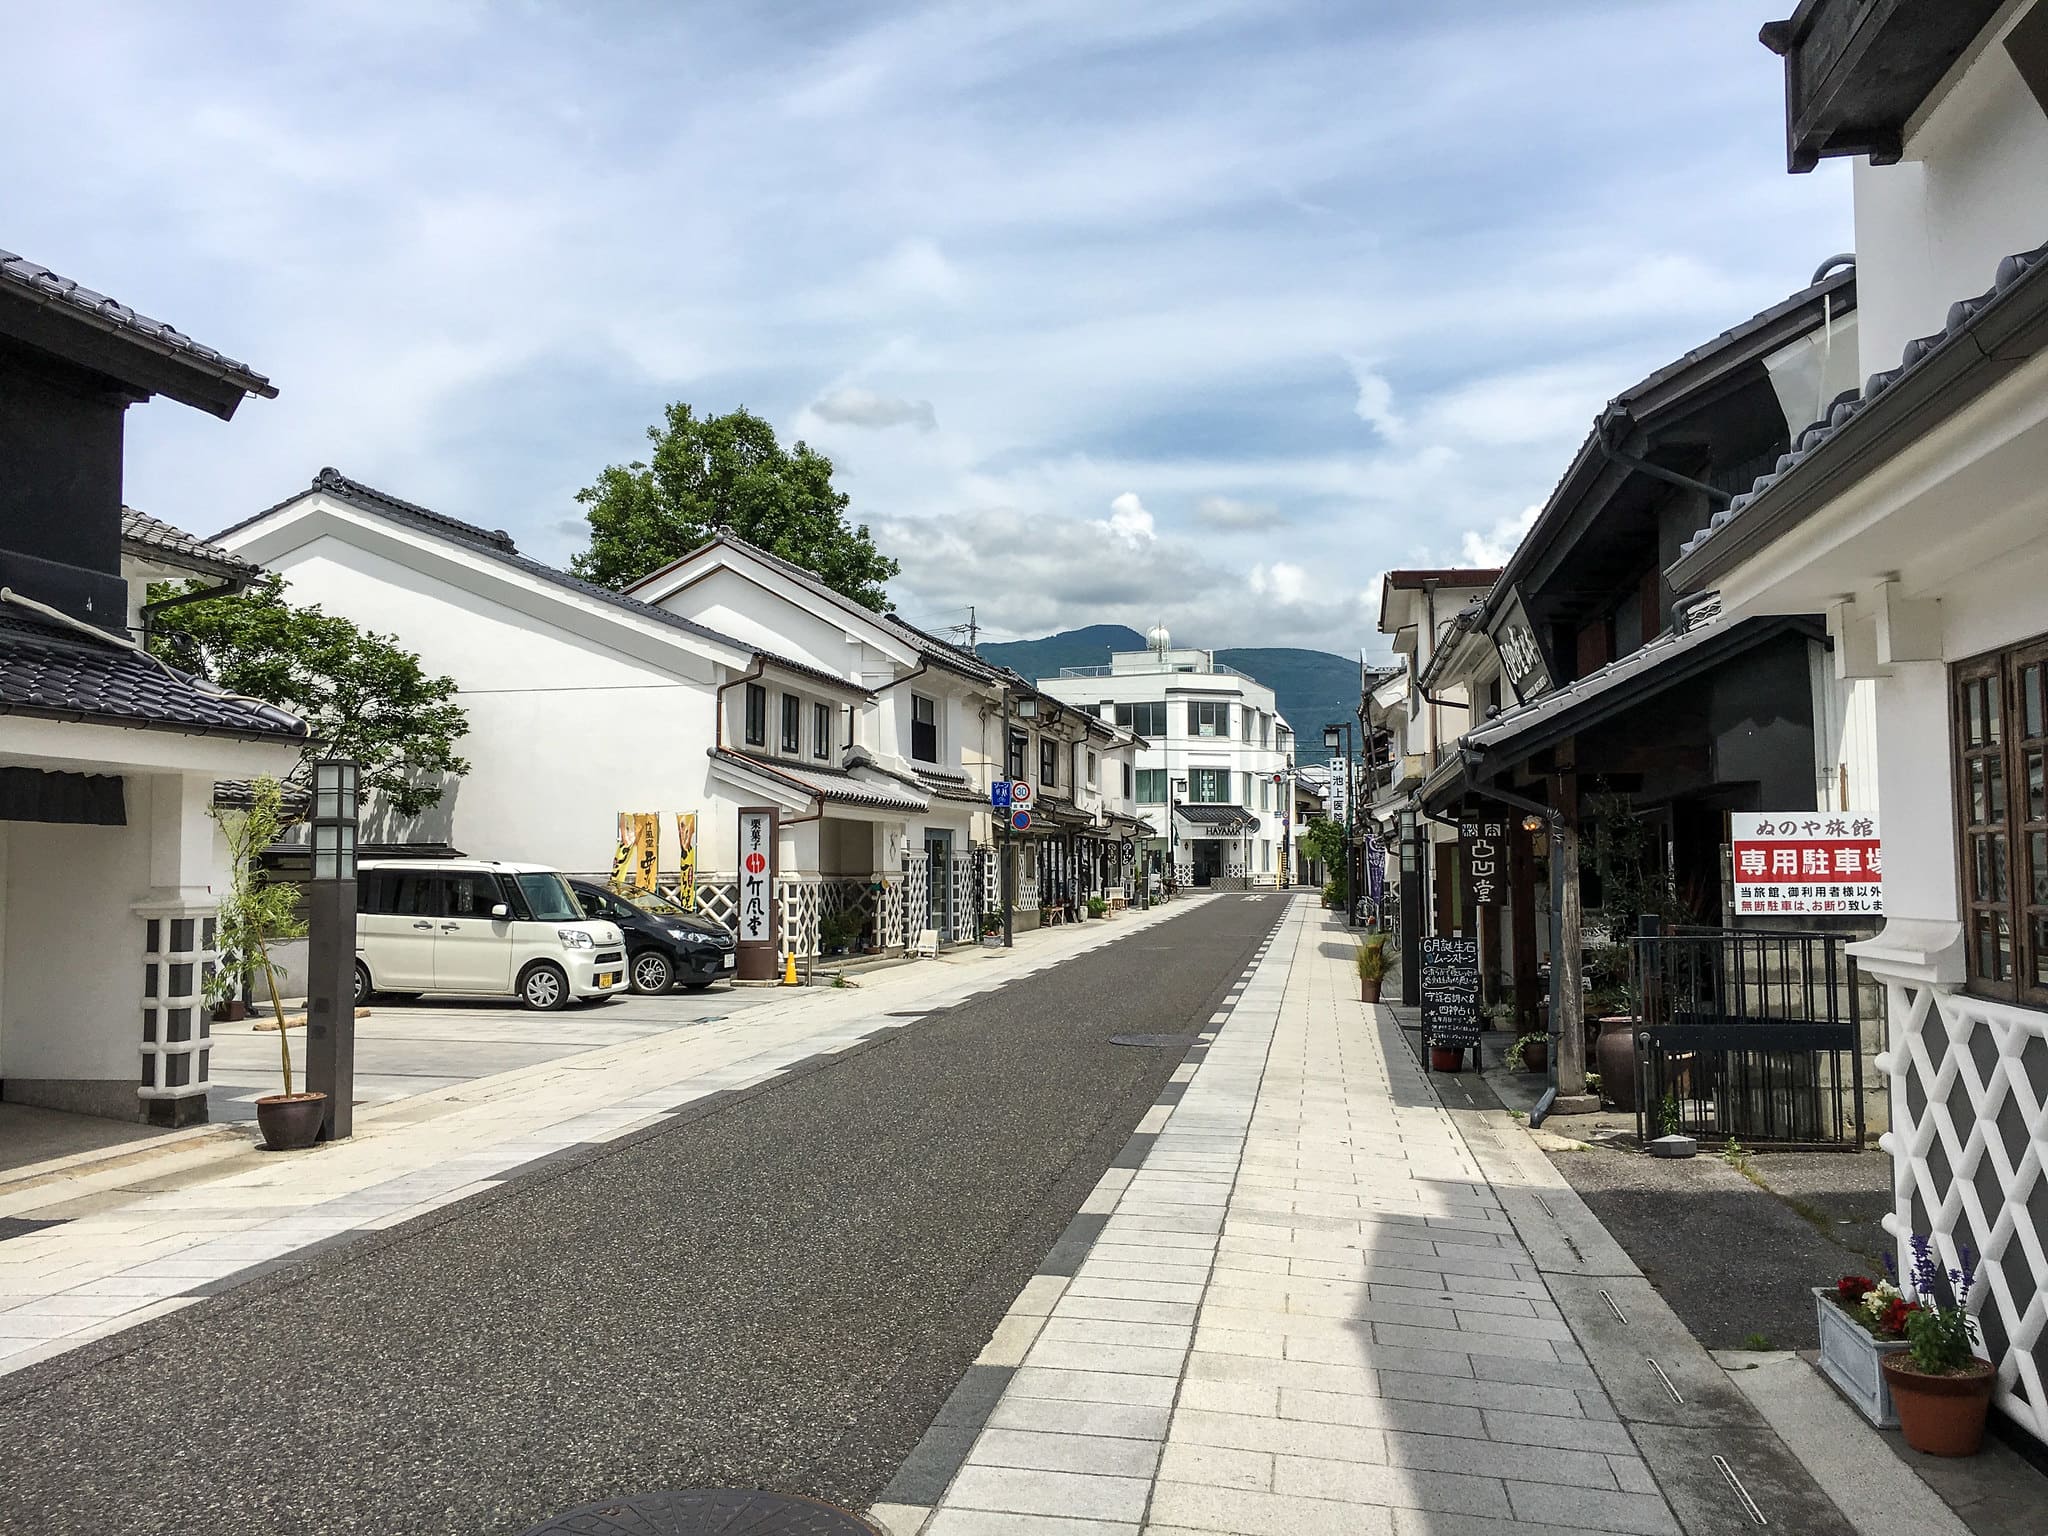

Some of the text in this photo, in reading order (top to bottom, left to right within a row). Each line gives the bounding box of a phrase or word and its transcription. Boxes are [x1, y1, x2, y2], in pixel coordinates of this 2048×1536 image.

[1016, 787, 1027, 796] 30
[751, 819, 761, 850] 栗菓子
[1756, 818, 1874, 837] ぬのや旅館
[746, 875, 765, 936] 竹風堂
[1423, 939, 1476, 953] 6月誕生石
